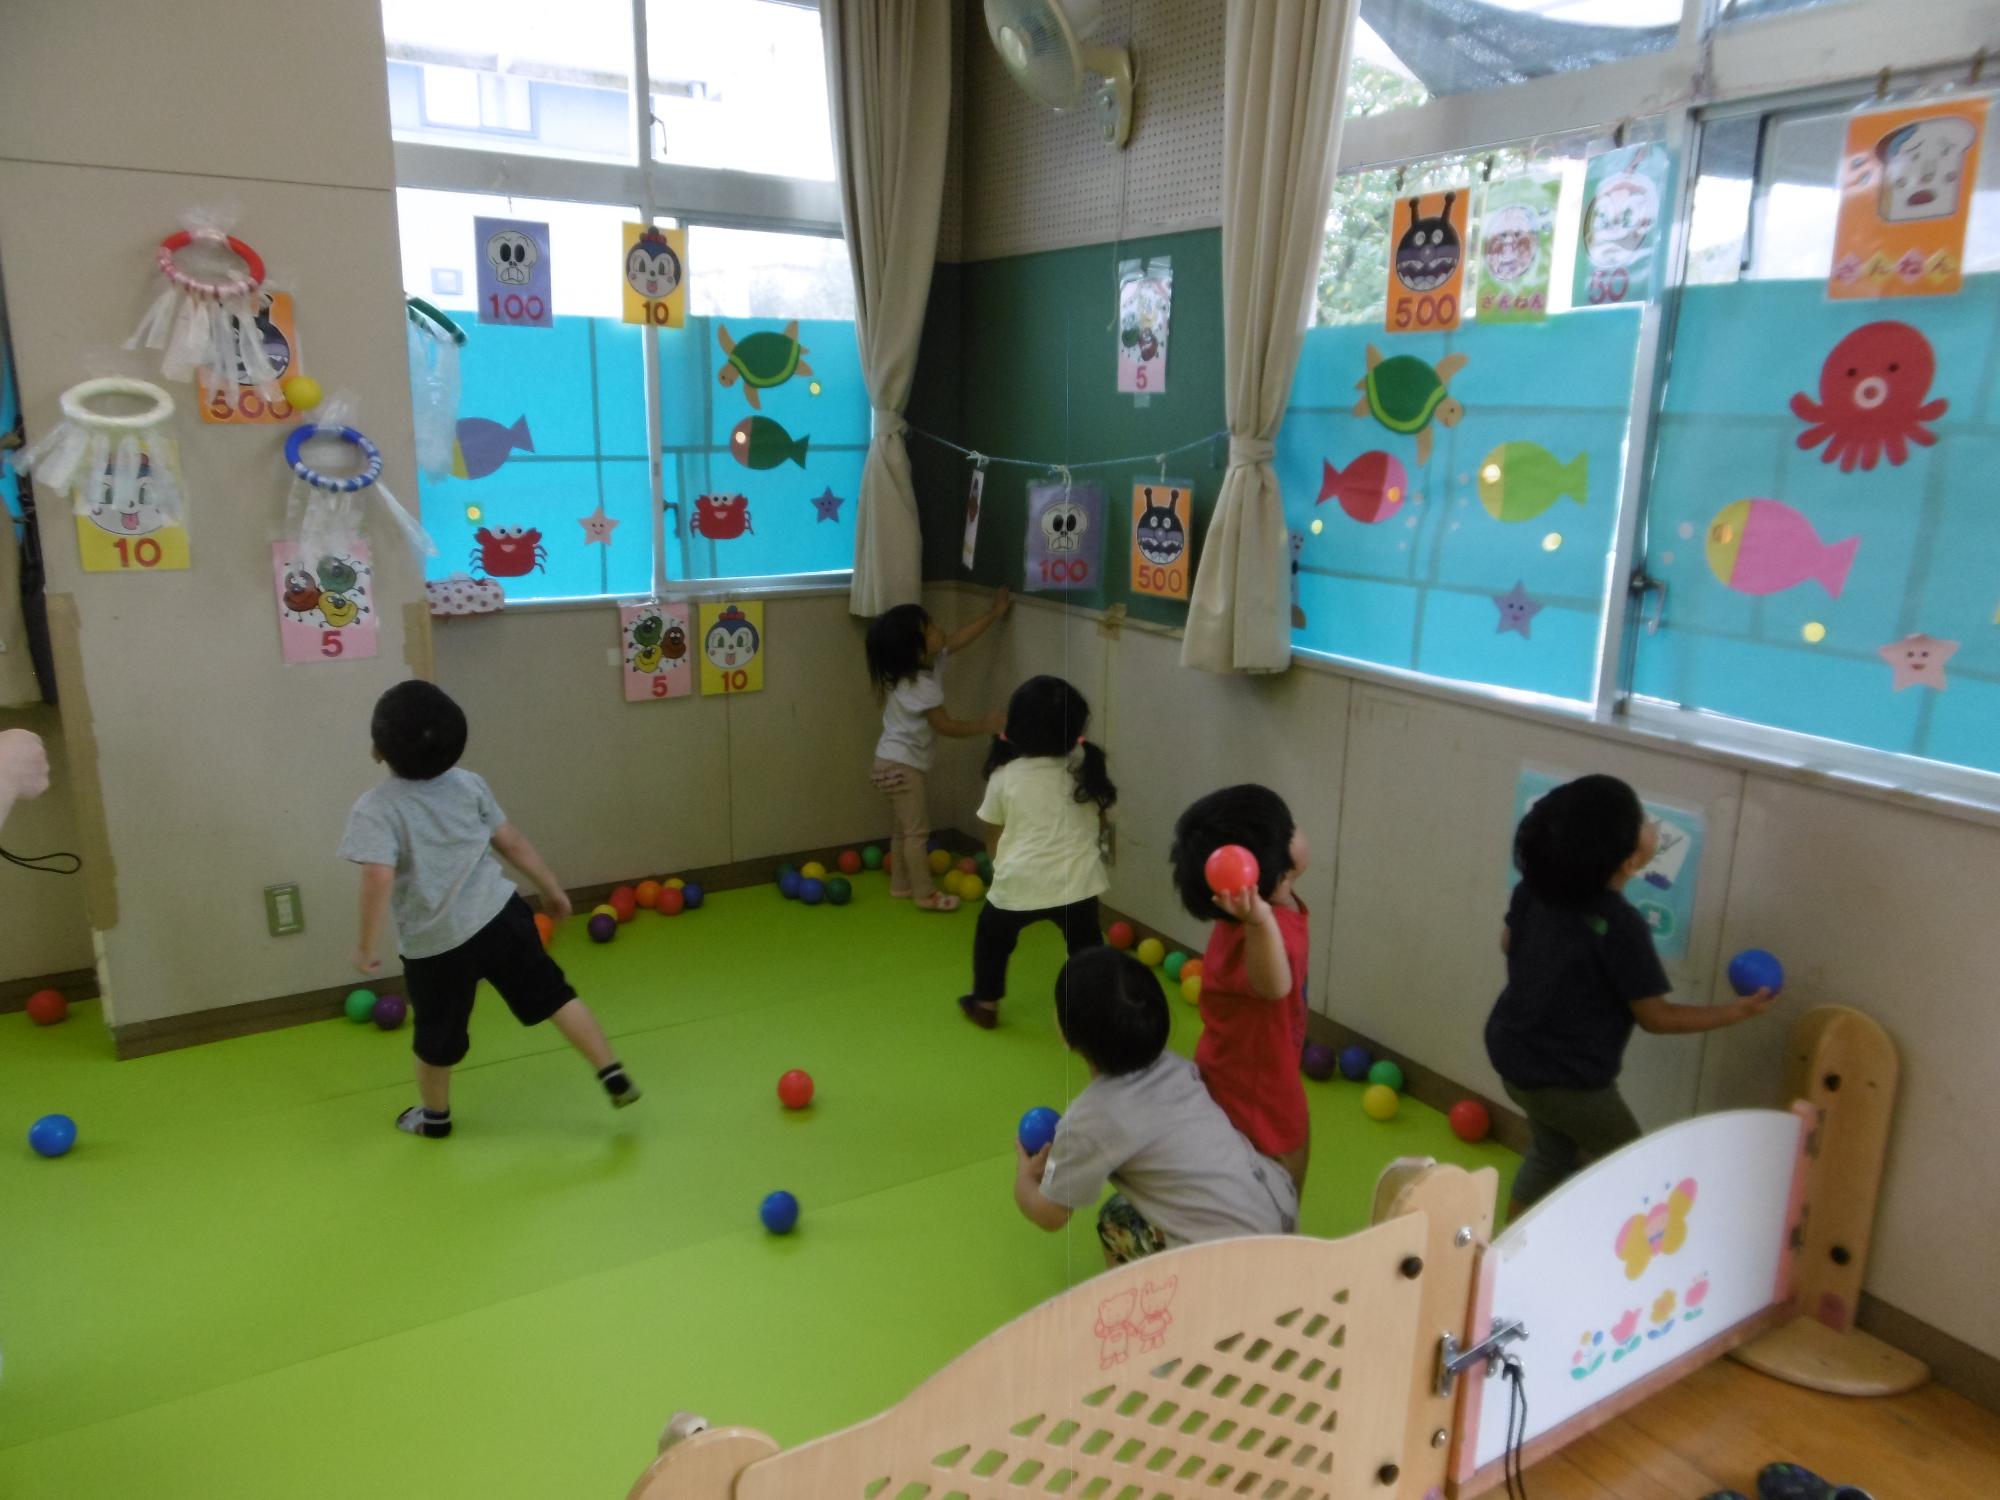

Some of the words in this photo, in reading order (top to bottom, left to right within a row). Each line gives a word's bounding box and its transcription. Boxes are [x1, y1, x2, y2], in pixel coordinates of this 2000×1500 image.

[1589, 268, 1629, 304] 50
[489, 294, 544, 320] 100
[642, 301, 669, 325] 10
[1395, 293, 1456, 328] 500
[1136, 366, 1149, 390] 5
[113, 537, 162, 568] 10
[1039, 559, 1088, 583] 100
[1138, 565, 1183, 593] 500
[321, 631, 343, 657] 5
[651, 676, 668, 697] 5
[721, 671, 748, 692] 10
